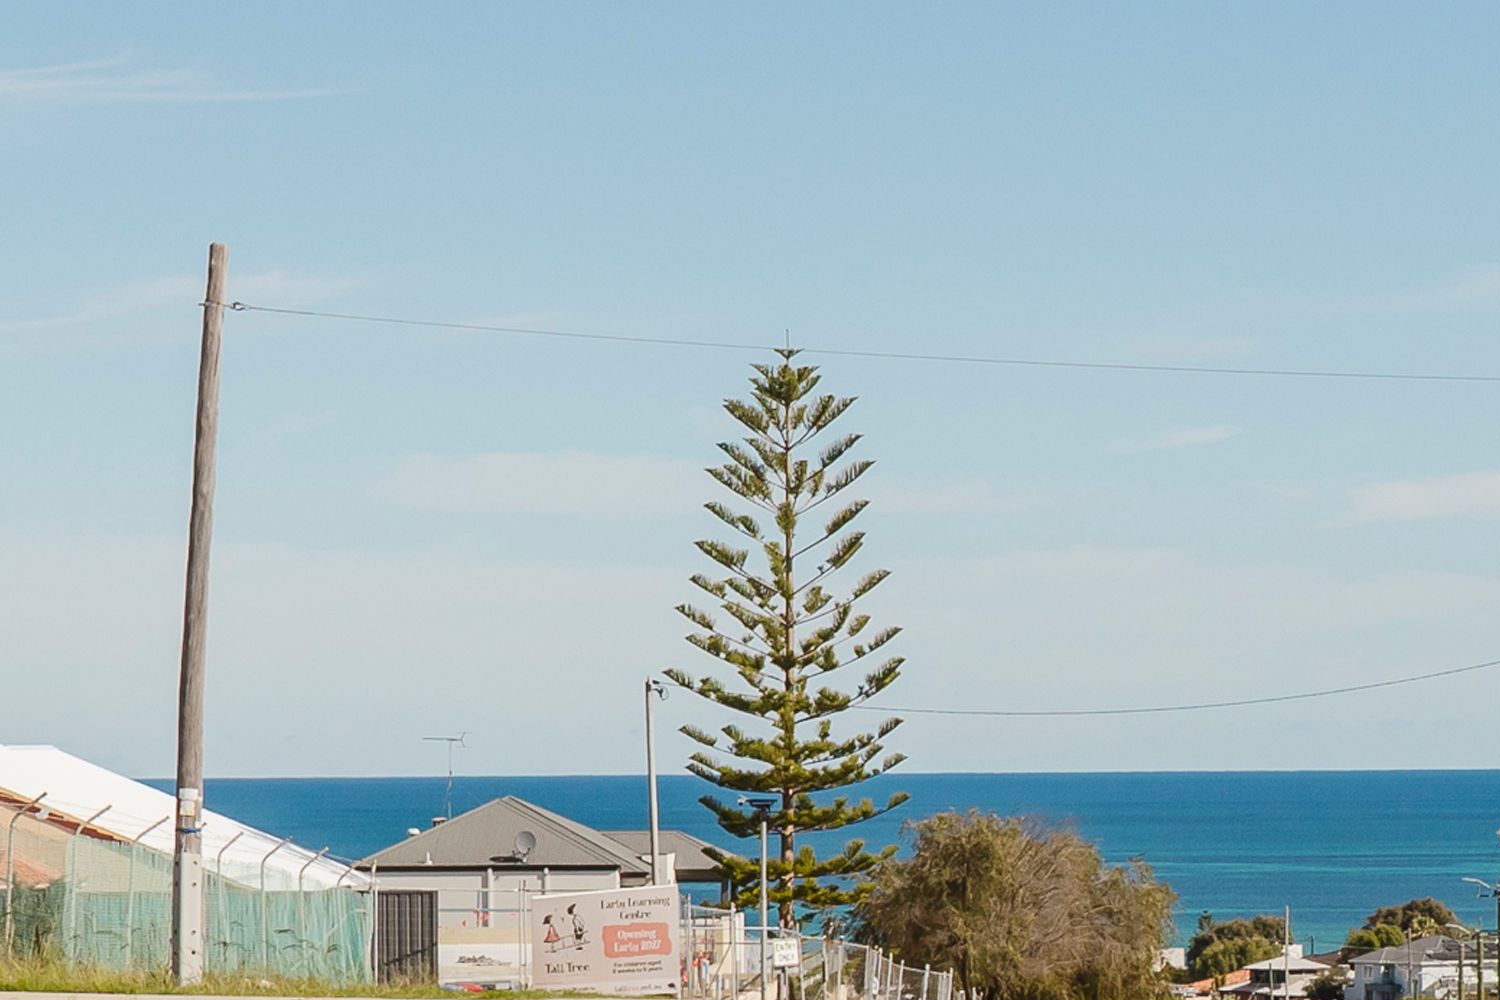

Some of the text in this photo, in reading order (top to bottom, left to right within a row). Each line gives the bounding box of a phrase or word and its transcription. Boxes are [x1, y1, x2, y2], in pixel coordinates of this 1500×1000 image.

[600, 897, 671, 910] Early Learning
[619, 910, 652, 919] Centre
[617, 929, 657, 941] Opening
[614, 942, 640, 953] Early
[545, 962, 590, 974] Tall Tree
